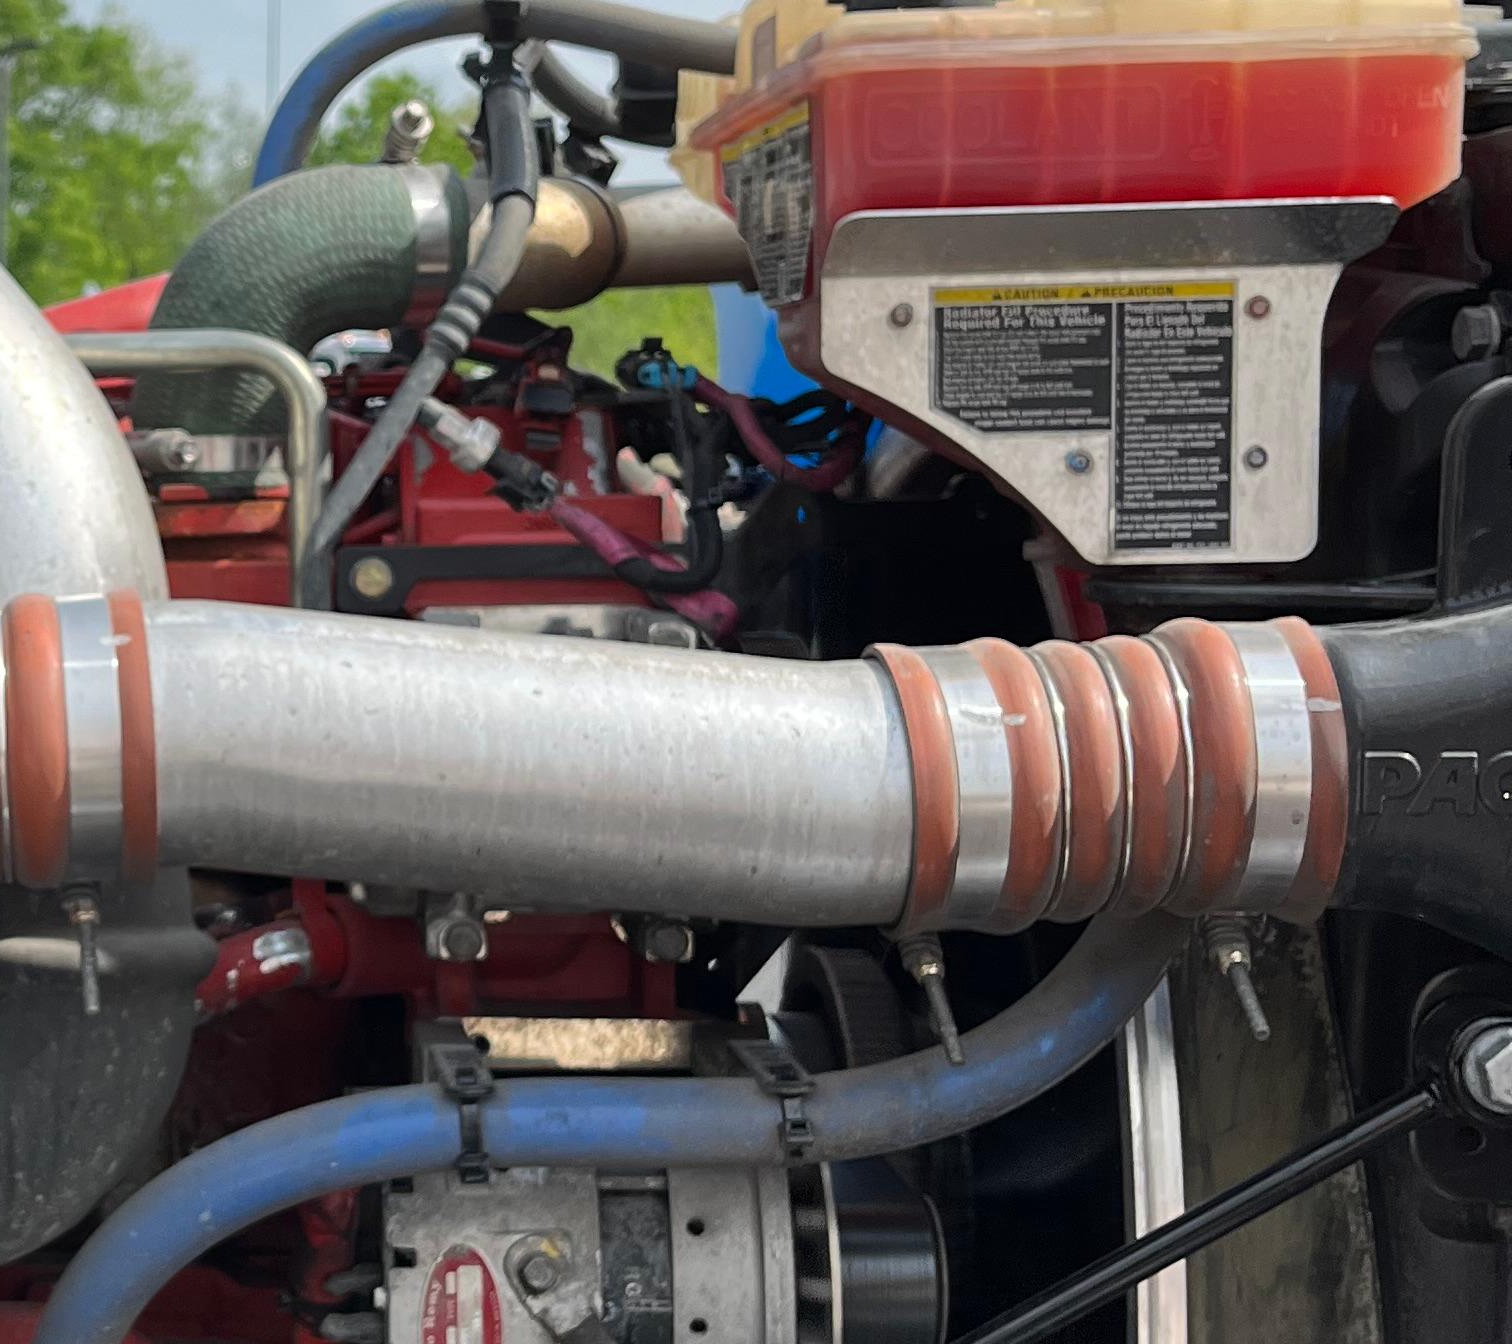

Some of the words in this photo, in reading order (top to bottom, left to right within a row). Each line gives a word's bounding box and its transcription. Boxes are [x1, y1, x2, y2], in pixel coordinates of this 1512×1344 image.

[1003, 288, 1059, 301] CAUTION
[943, 306, 998, 319] Radiator
[943, 317, 1000, 331] Required
[1004, 316, 1024, 328] For
[1029, 316, 1055, 328] This
[1060, 314, 1106, 327] Vehicle
